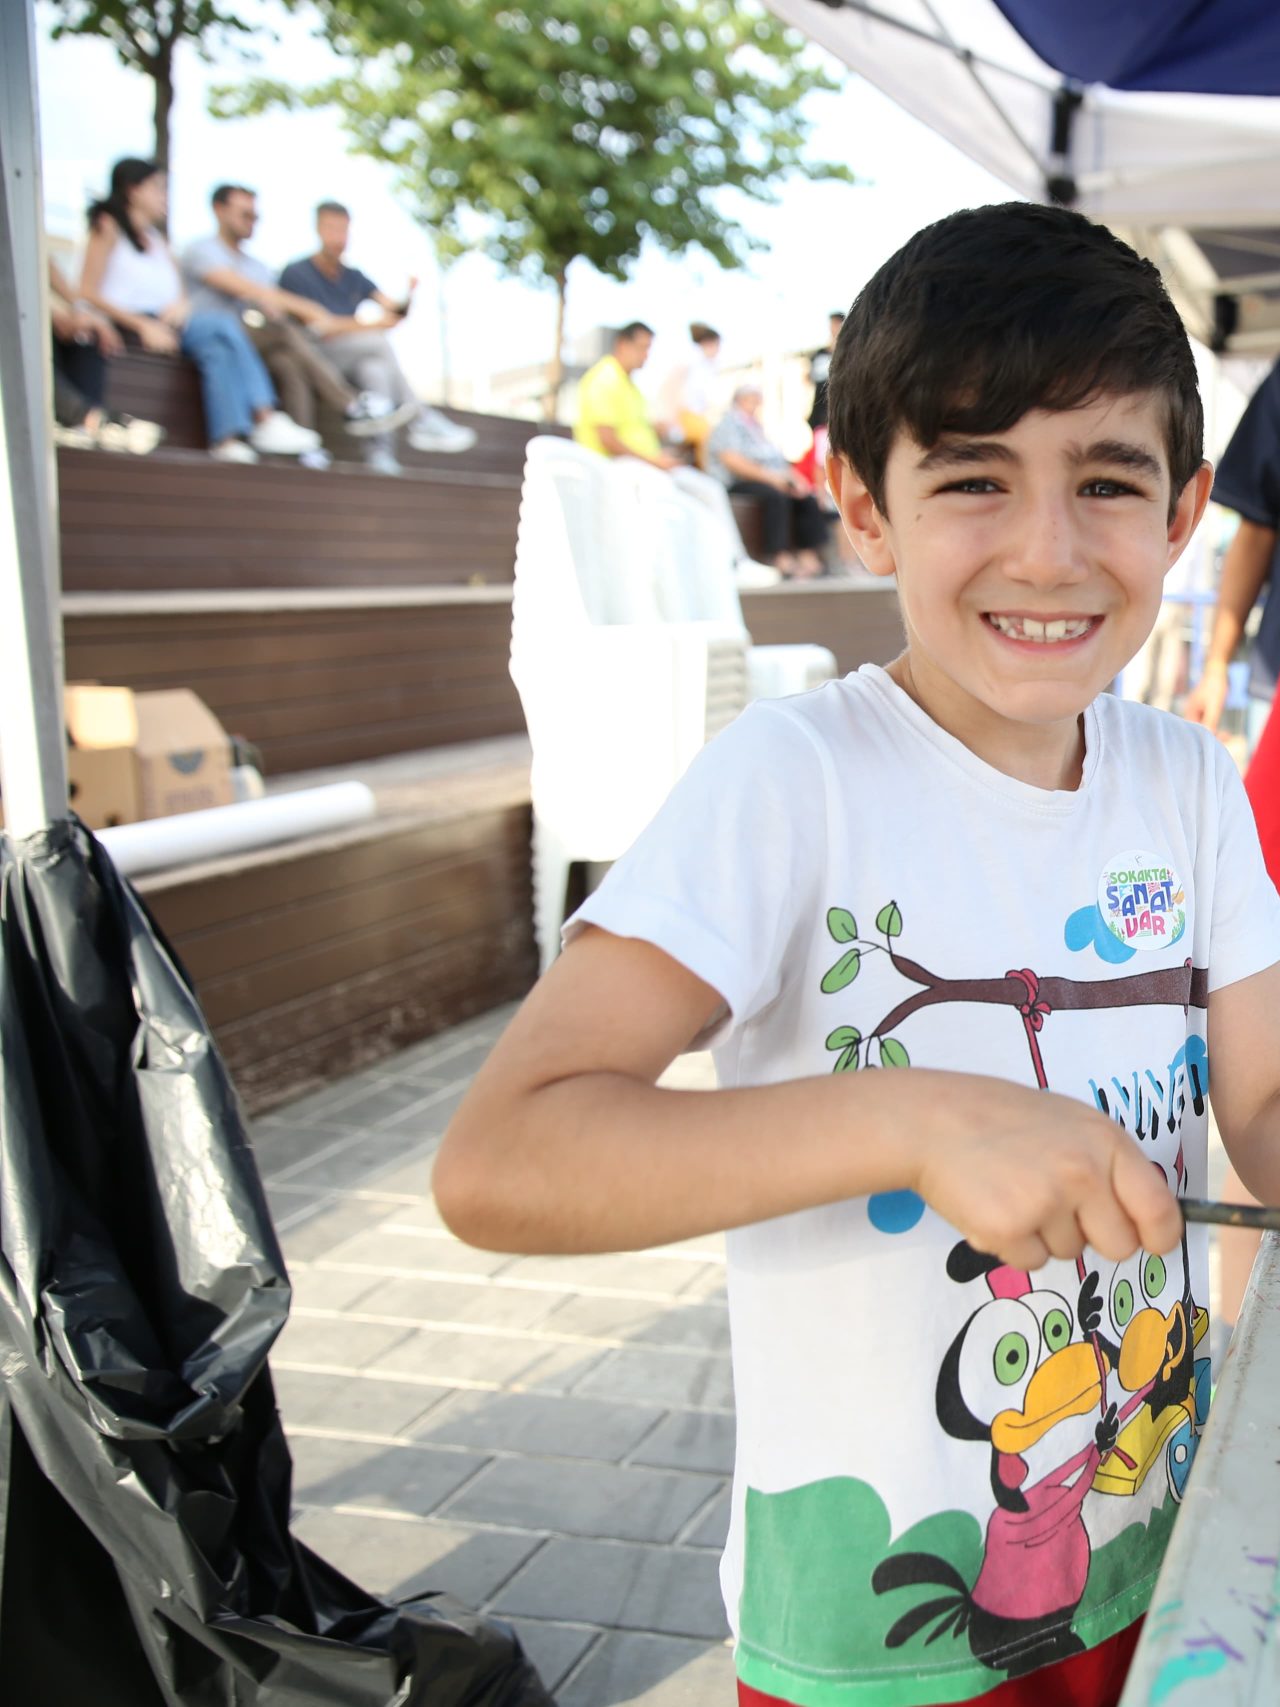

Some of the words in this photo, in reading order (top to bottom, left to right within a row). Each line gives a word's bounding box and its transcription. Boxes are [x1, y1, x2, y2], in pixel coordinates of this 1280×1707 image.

[1109, 868, 1167, 885] SOKAKTA
[1106, 881, 1174, 917] SANAT
[1125, 910, 1166, 938] VAR
